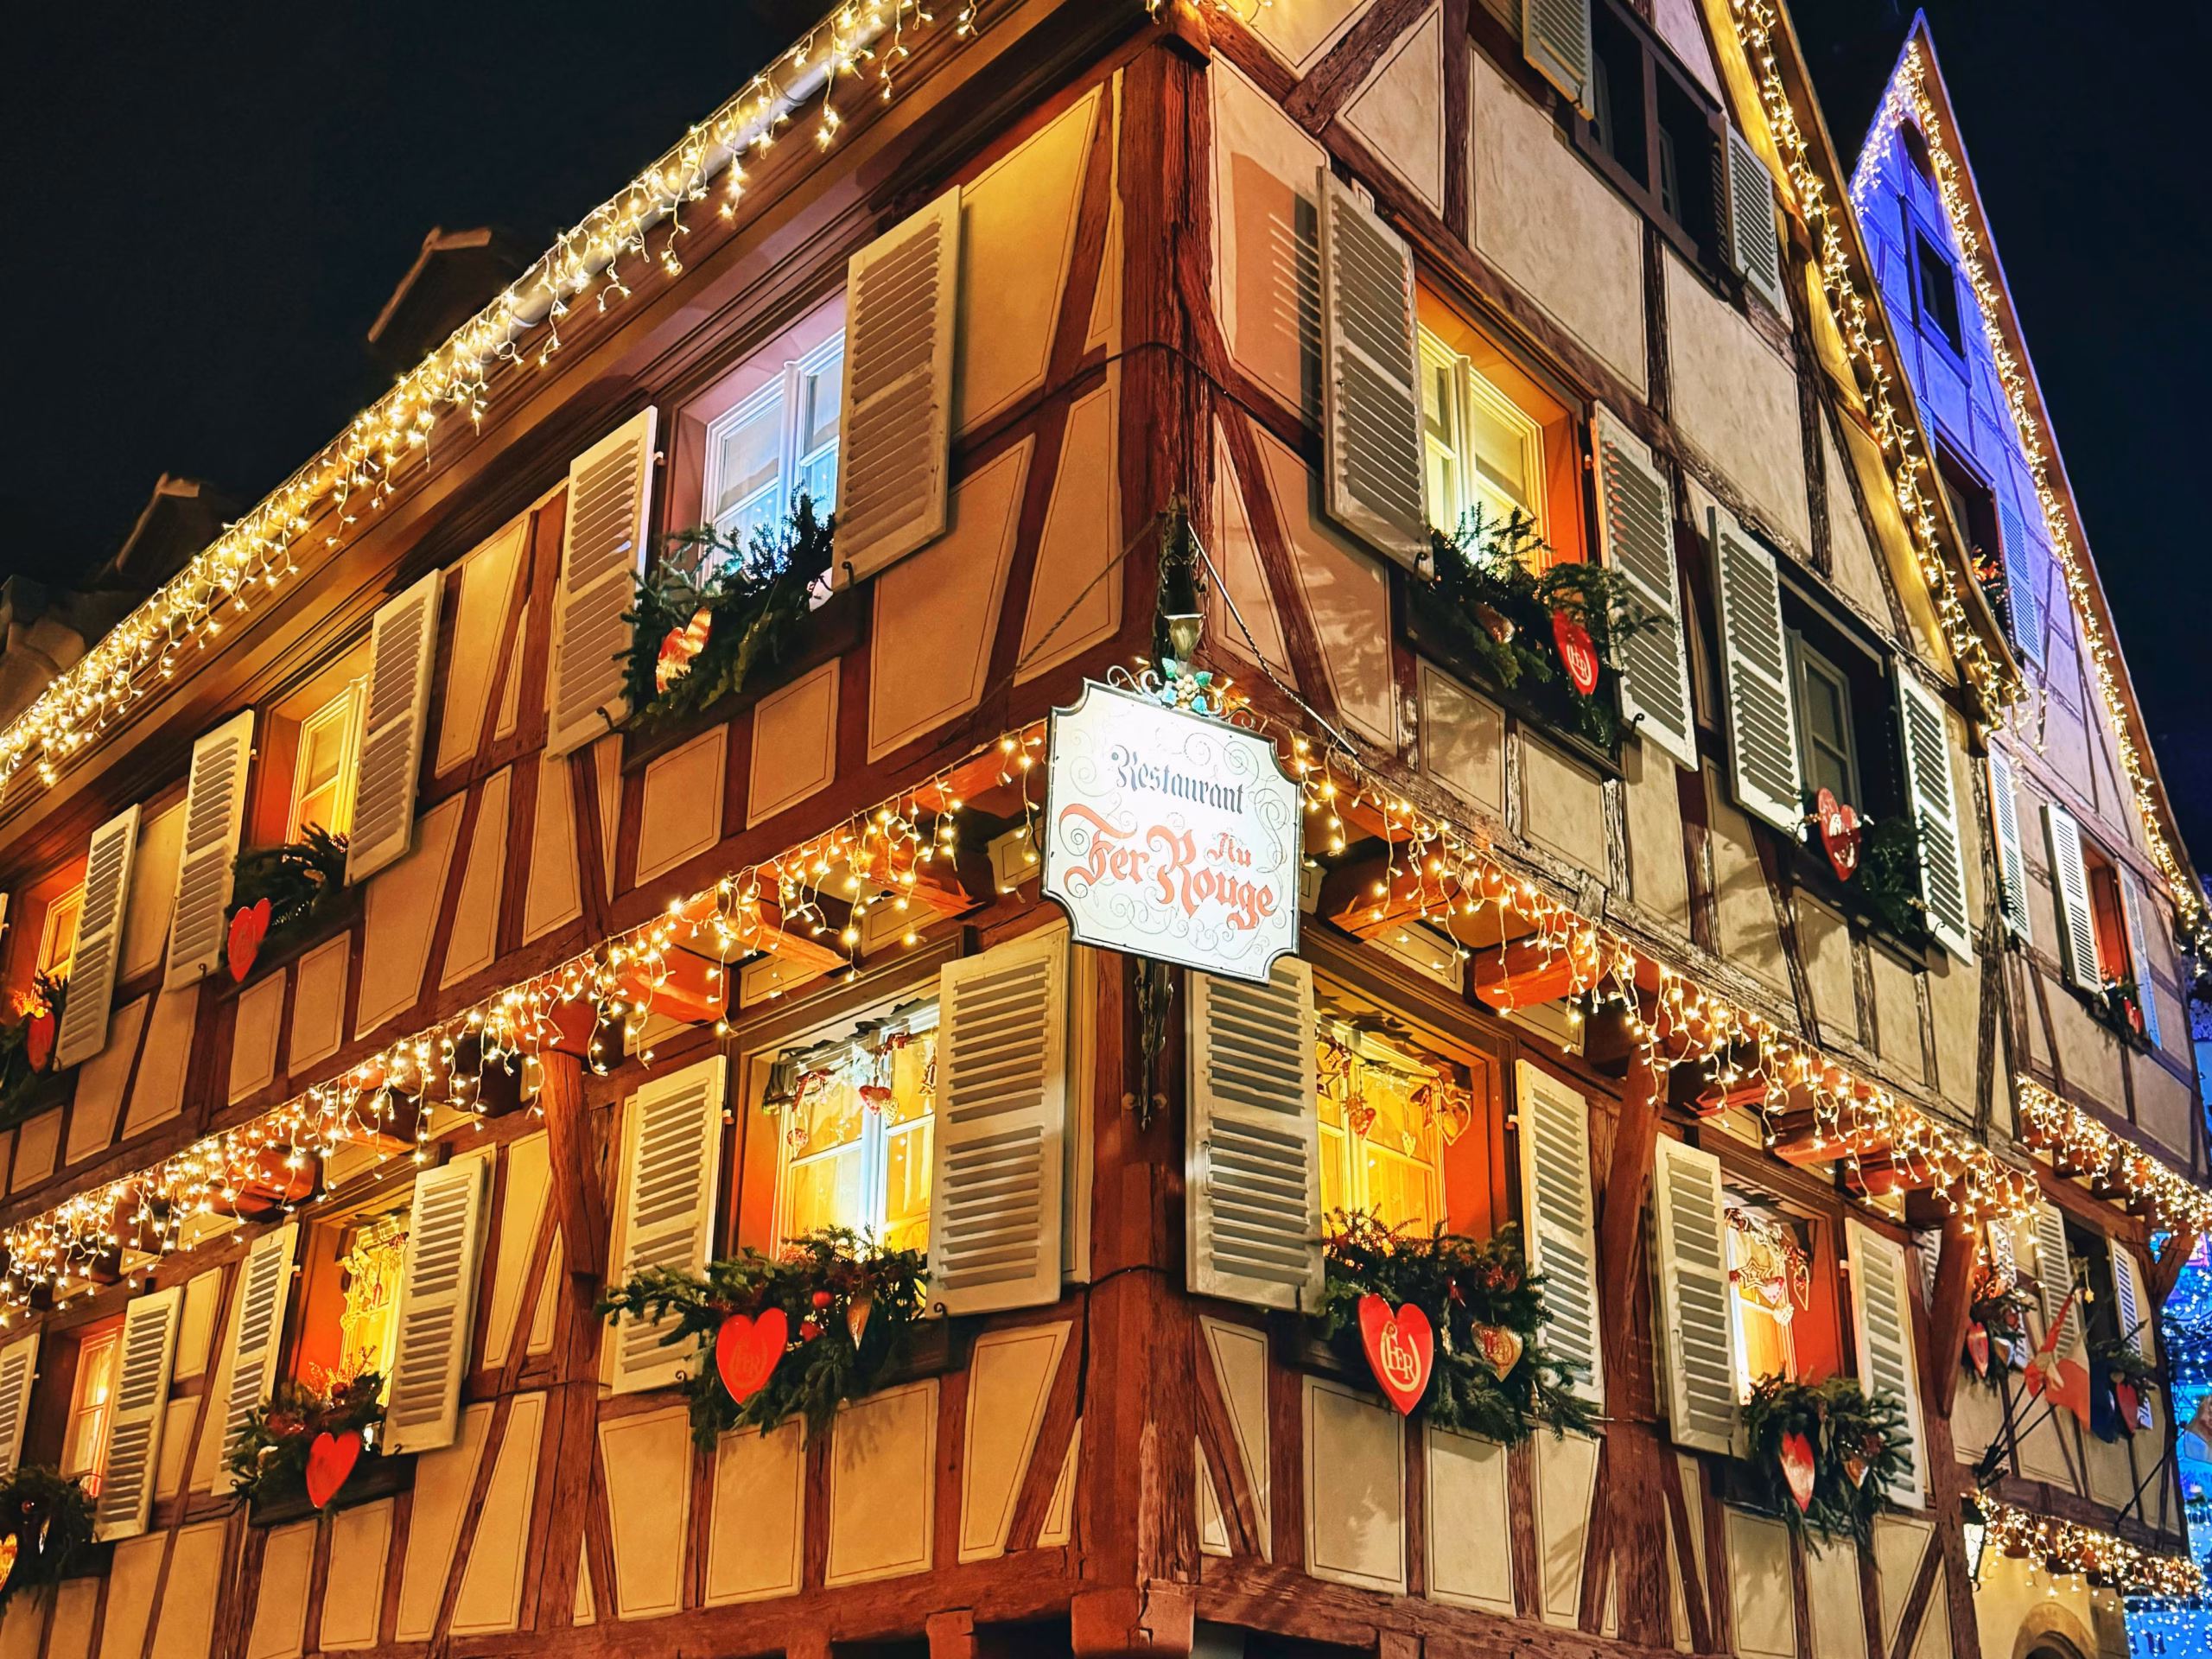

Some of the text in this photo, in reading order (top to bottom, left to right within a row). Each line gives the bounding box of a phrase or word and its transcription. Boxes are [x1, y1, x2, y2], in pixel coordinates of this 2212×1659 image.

[1111, 745, 1243, 815] Restaurant
[1059, 804, 1276, 930] Fer Rouge
[1206, 831, 1252, 867] Au
